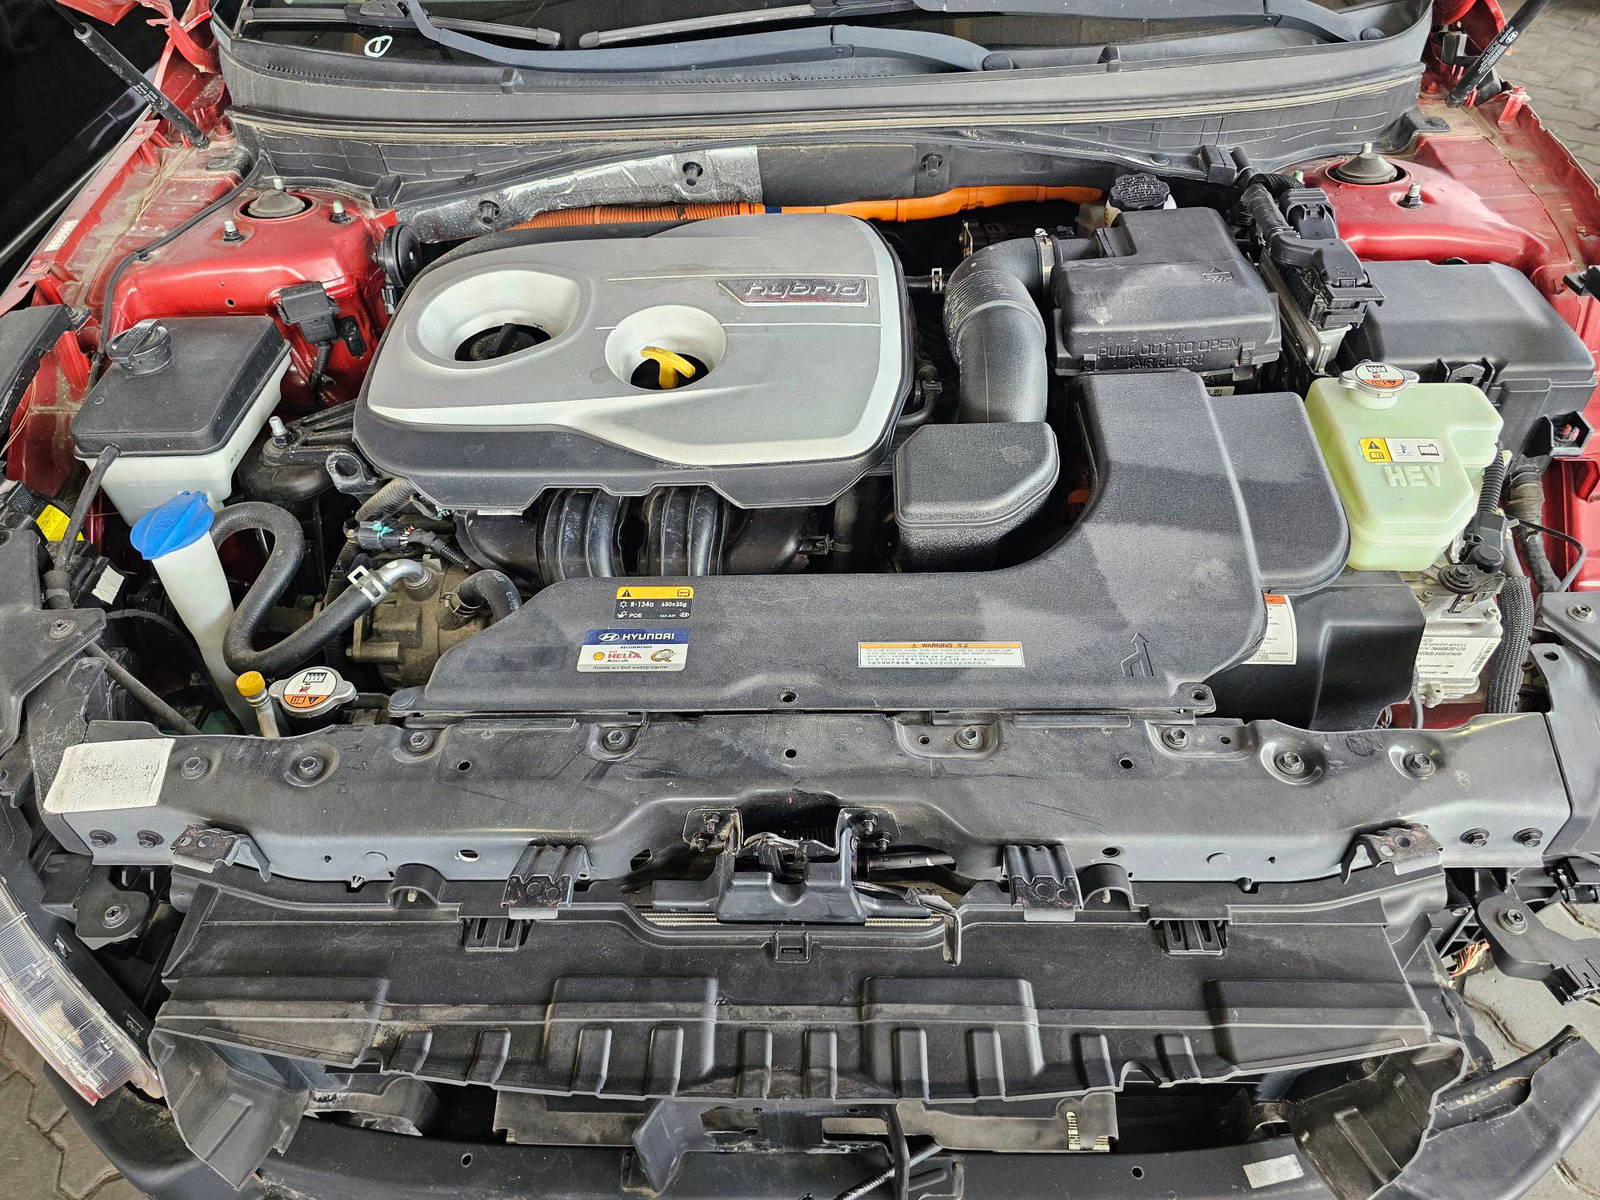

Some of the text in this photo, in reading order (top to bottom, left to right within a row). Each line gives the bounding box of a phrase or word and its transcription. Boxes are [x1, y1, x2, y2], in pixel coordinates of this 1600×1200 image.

[1097, 337, 1240, 358] PULL OUT TO OPEN
[1384, 465, 1441, 487] HEV
[608, 651, 642, 659] HELIX
